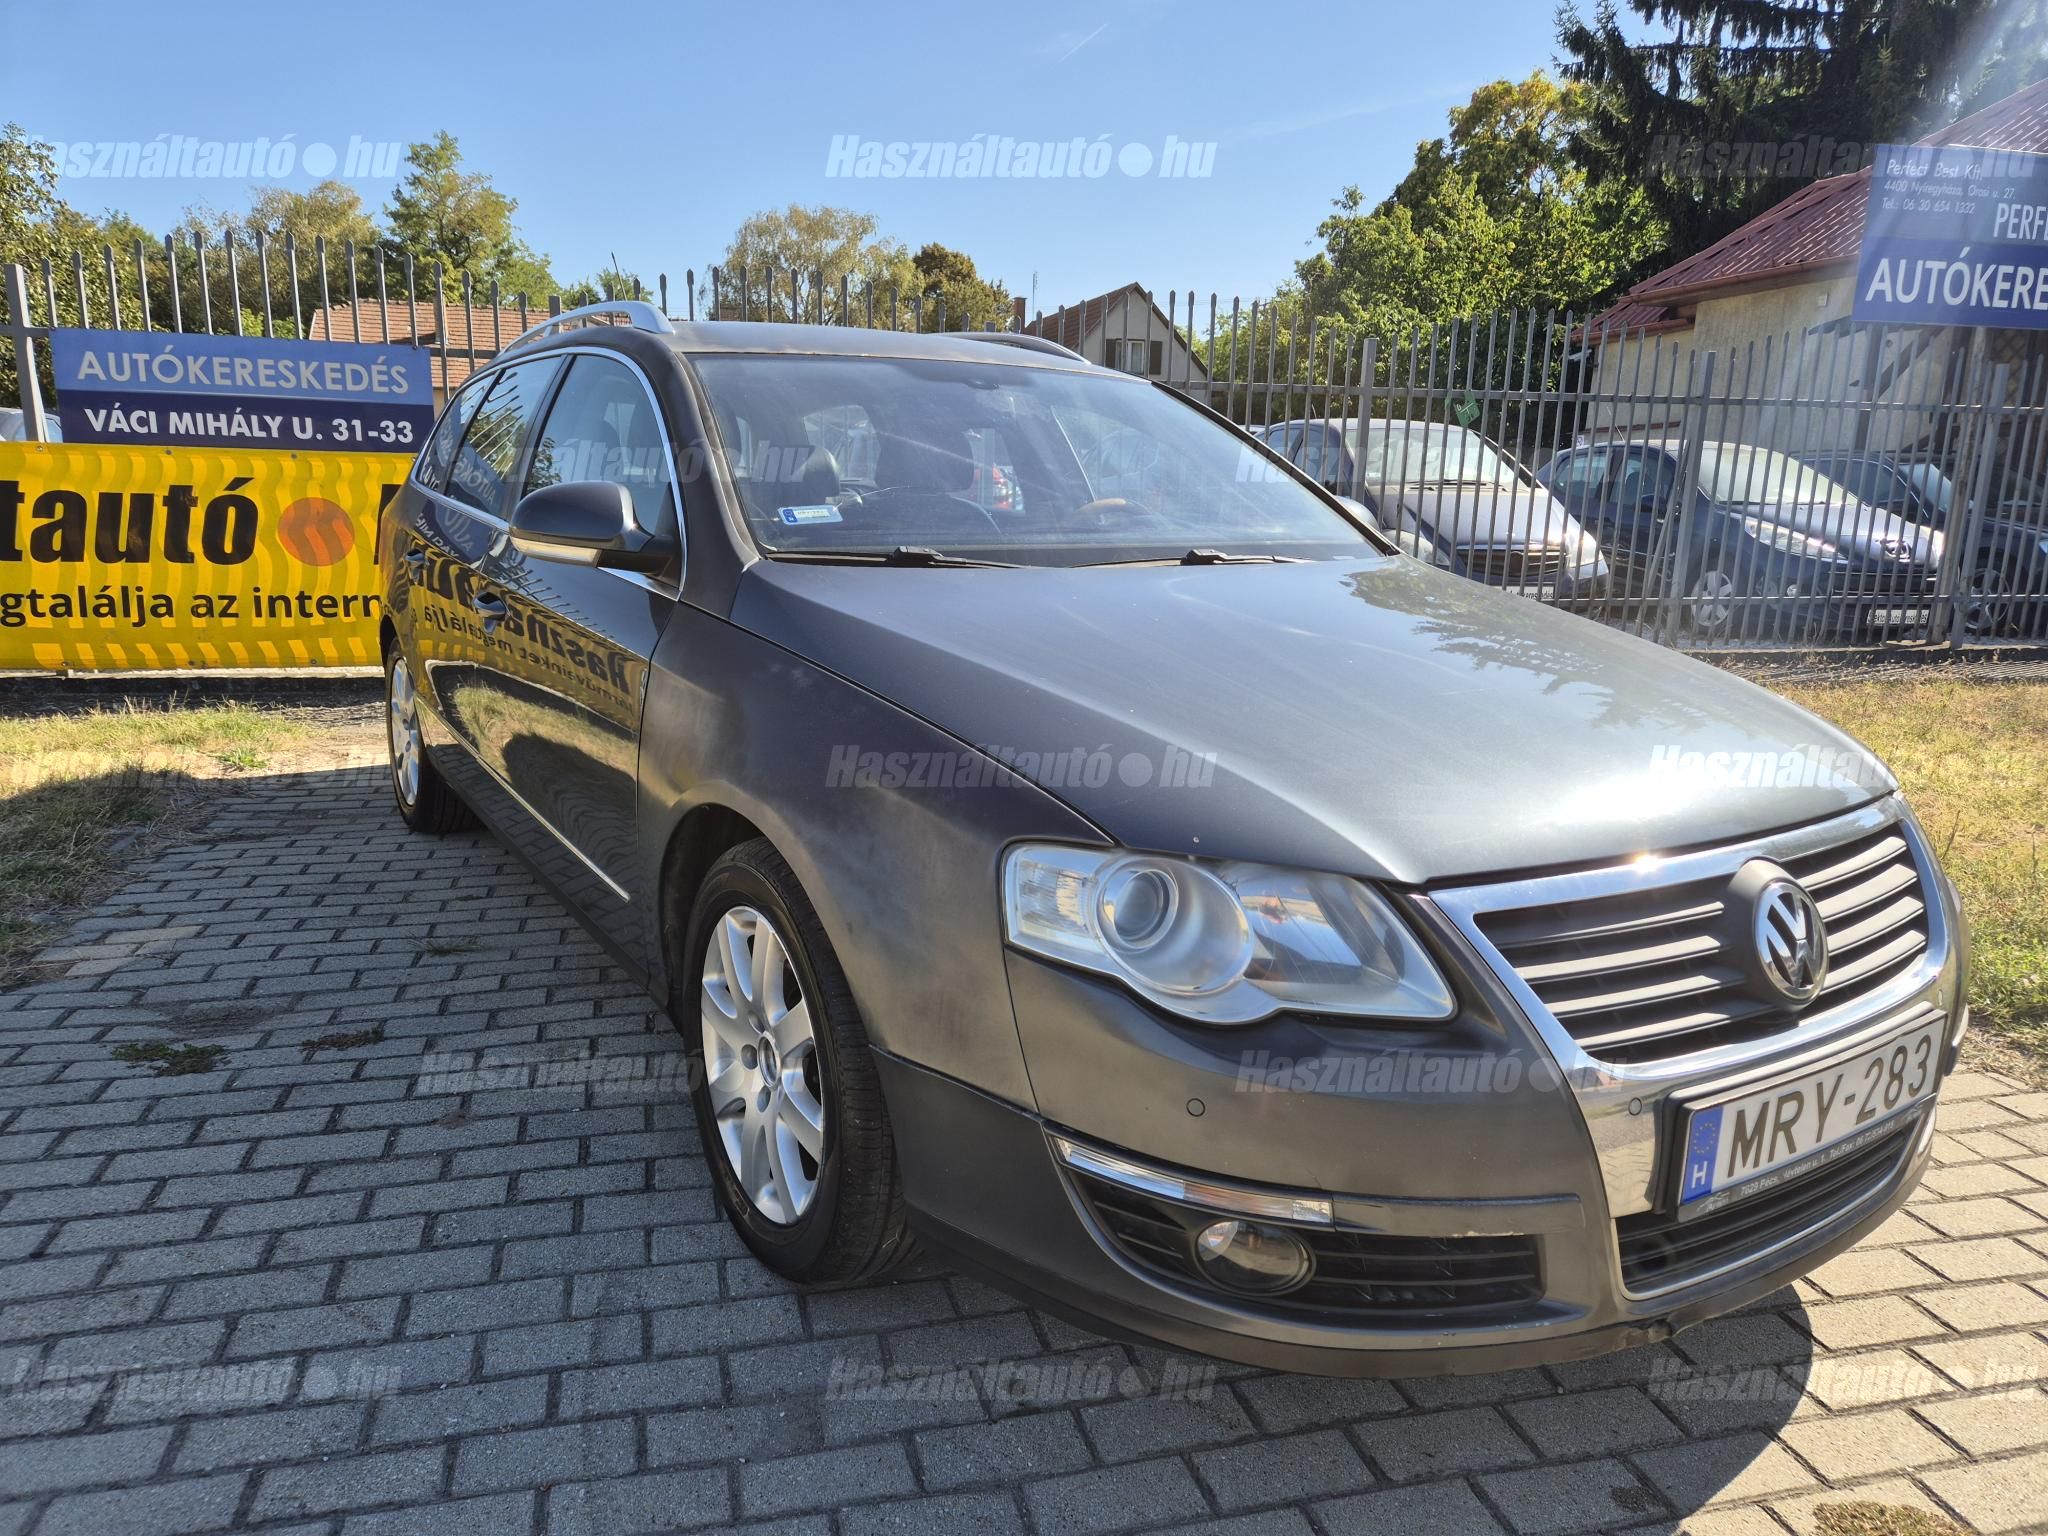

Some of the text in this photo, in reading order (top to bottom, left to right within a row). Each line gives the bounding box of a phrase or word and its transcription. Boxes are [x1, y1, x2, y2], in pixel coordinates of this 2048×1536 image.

[1886, 159, 1929, 177] Perfect
[1934, 162, 1959, 178] Best
[1884, 179, 1908, 193] 4400
[1903, 198, 1915, 210] 06
[1918, 199, 1930, 211] 30
[77, 345, 409, 394] AUTÓKERESKEDÉS
[84, 402, 414, 444] VÁCI MIHÁLY U. 31-33
[190, 594, 240, 619] az
[1727, 1034, 1931, 1178] MRY-283
[1691, 1160, 1708, 1189] H
